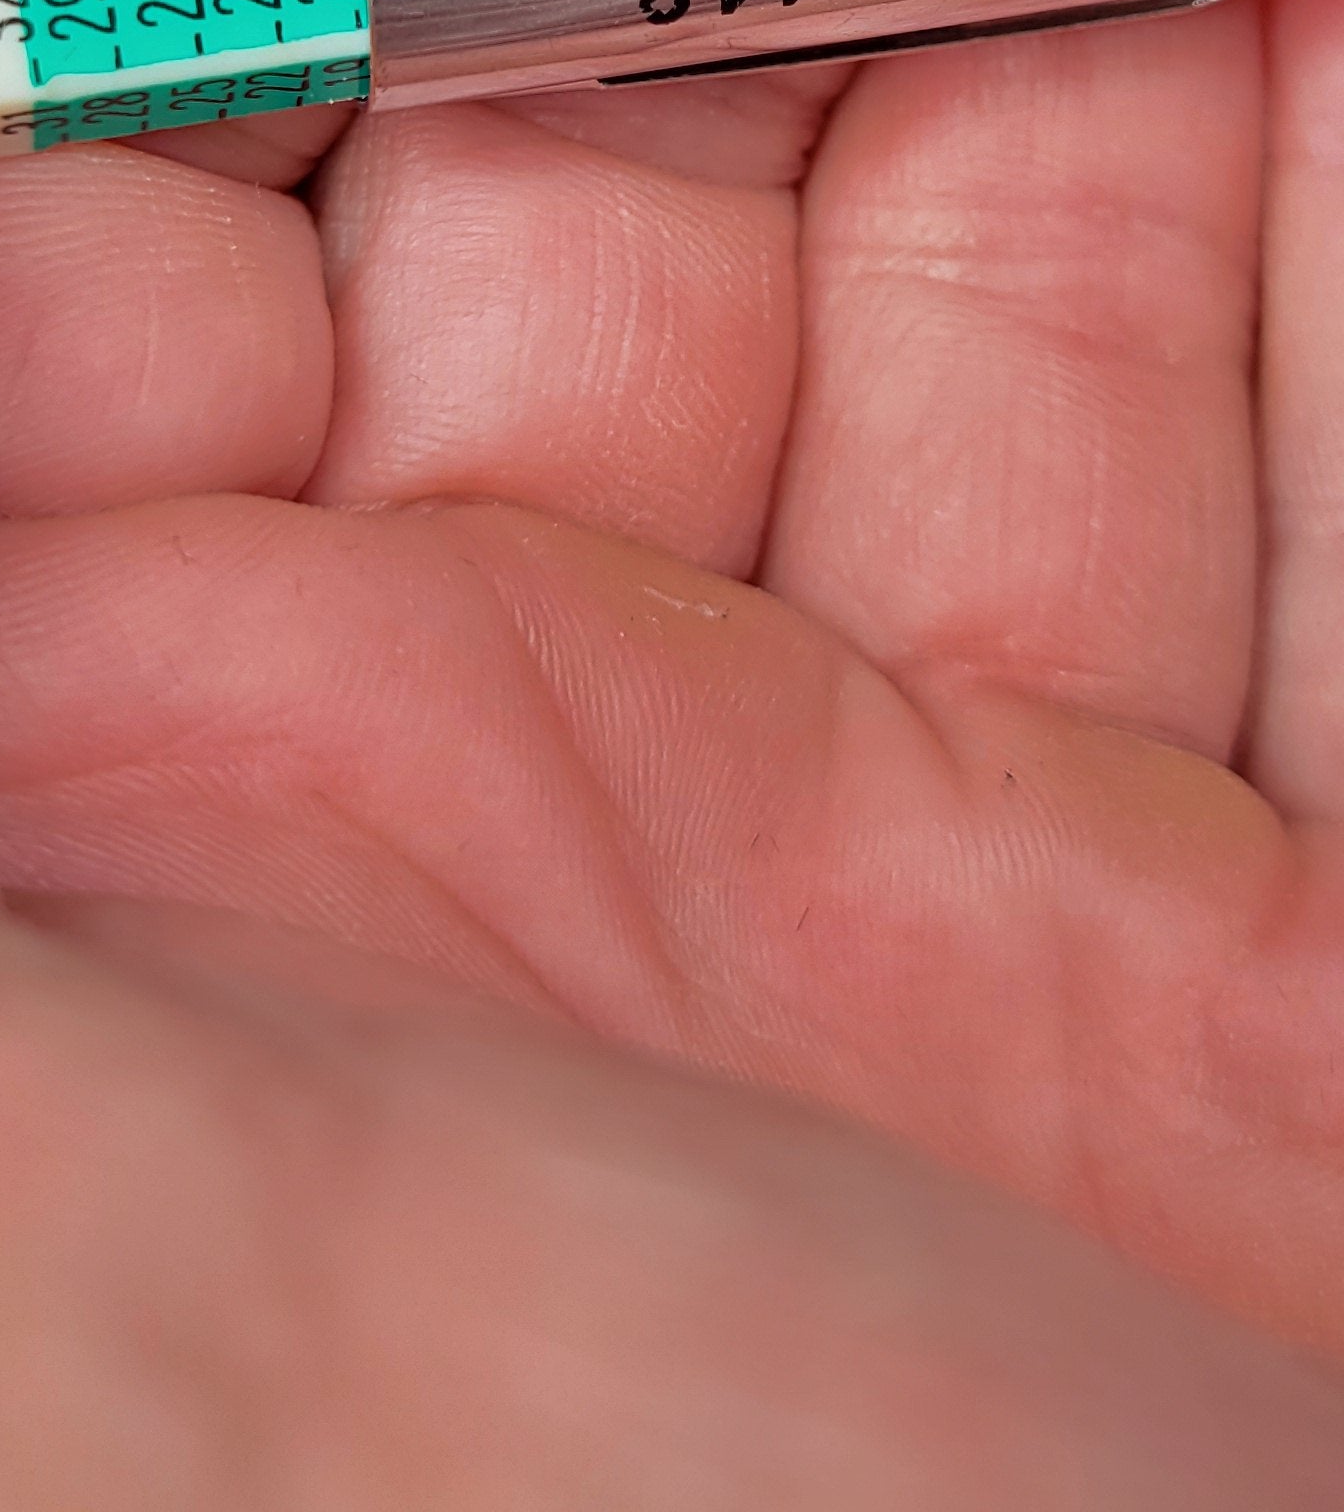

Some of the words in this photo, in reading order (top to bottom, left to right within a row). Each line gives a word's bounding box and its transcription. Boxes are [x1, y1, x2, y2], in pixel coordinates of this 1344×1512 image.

[168, 78, 237, 111] 25
[244, 65, 312, 99] 22
[0, 103, 70, 135] 31
[81, 91, 150, 125] 28
